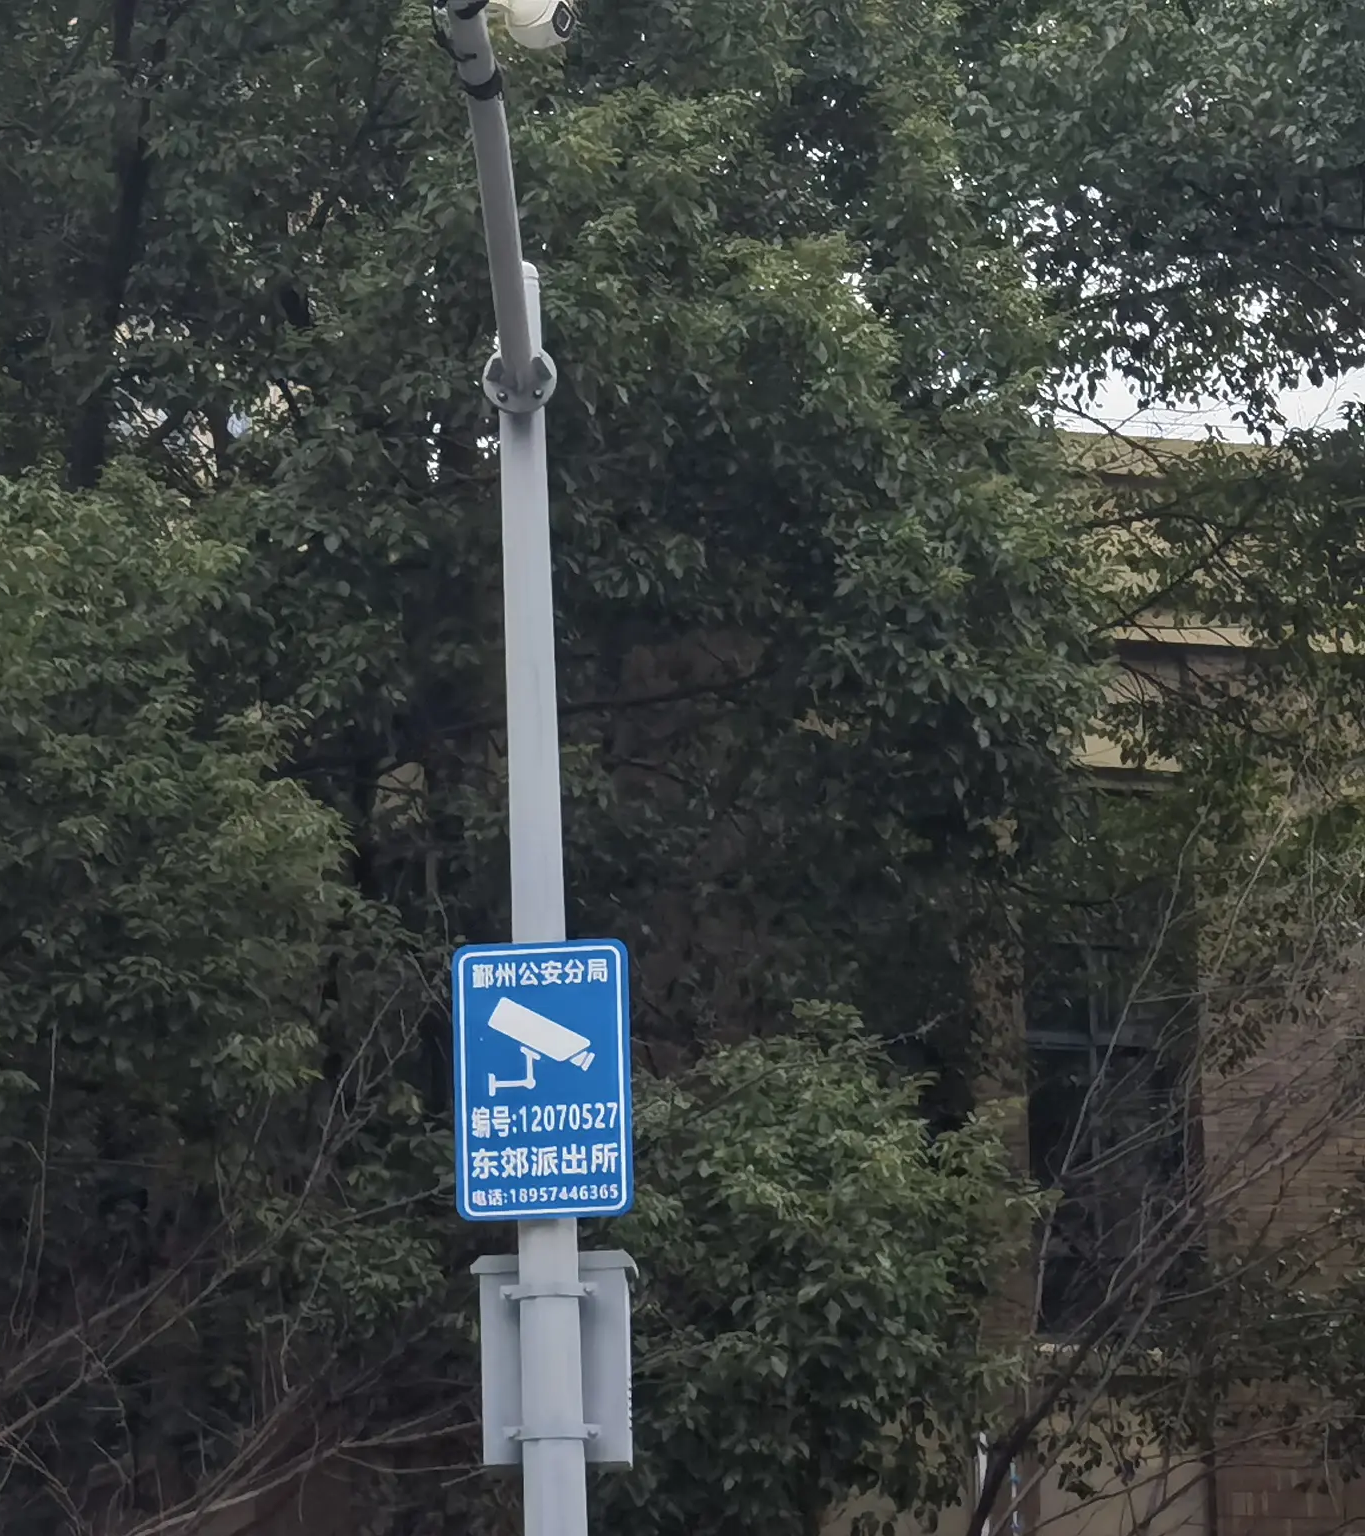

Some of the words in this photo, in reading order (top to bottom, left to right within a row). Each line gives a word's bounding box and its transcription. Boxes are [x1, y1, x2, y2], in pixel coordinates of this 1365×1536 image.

[472, 958, 608, 988] 鄞州公安分局
[471, 1102, 618, 1138] 编号:12070527
[471, 1142, 618, 1179] 东郊派出所
